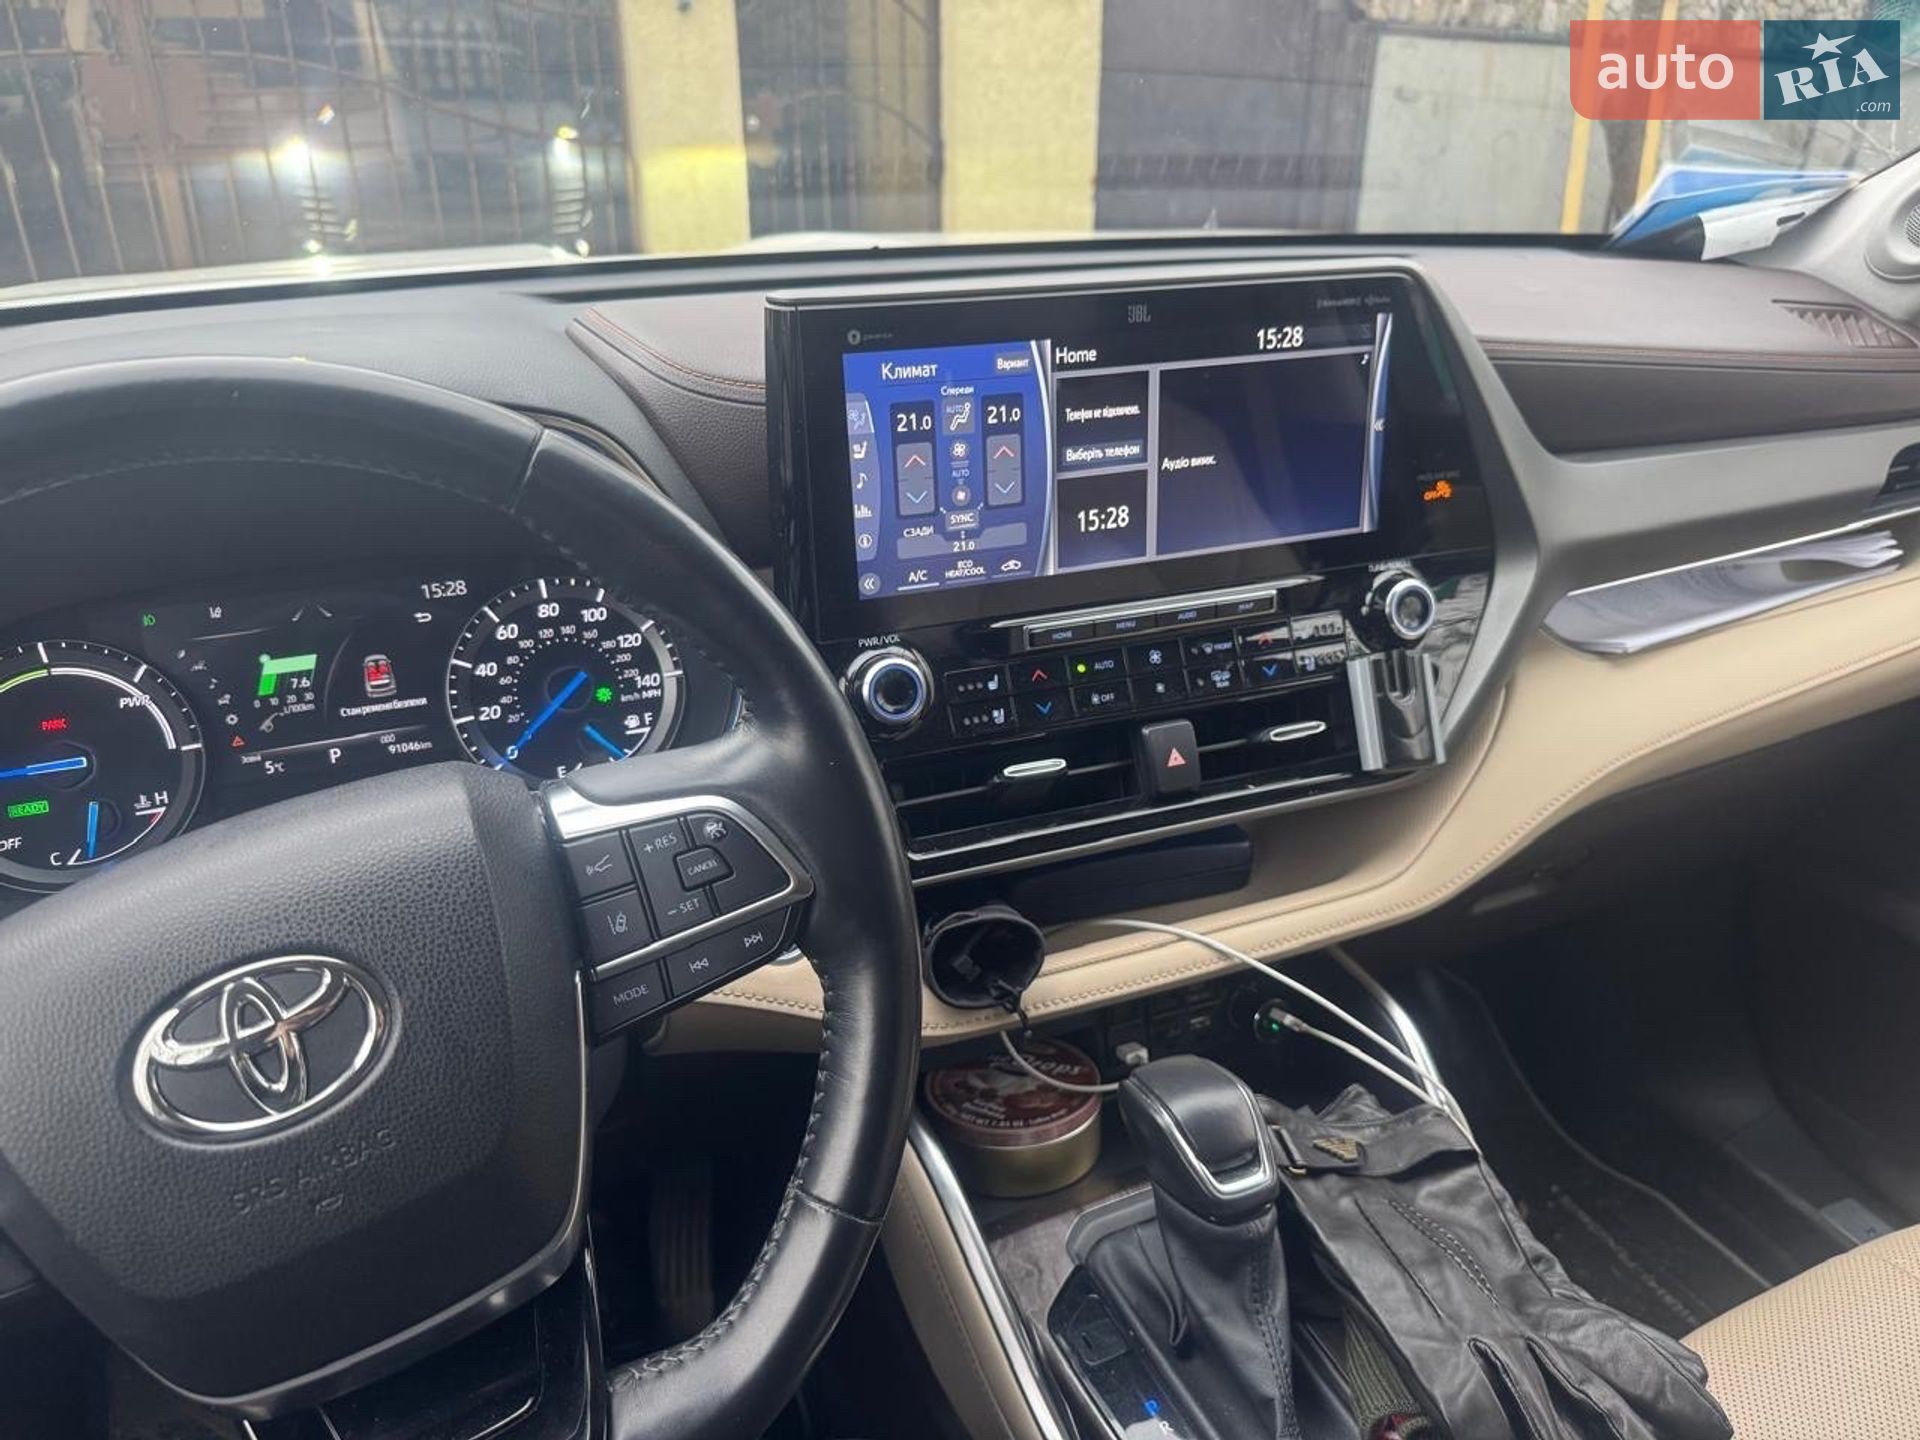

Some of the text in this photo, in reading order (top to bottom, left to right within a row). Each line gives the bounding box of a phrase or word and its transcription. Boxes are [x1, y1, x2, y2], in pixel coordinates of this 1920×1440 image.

[1127, 303, 1151, 323] JBL
[1256, 325, 1303, 350] 15:28
[1055, 347, 1097, 364] Home
[881, 362, 939, 380] Климат
[987, 405, 1021, 424] 21.0
[896, 412, 932, 432] 21.0
[1066, 442, 1140, 462] Виберіть телефон
[1161, 456, 1190, 472] Аудіо
[952, 469, 970, 477] AUTO
[950, 513, 976, 525] SYNC
[1077, 505, 1130, 533] 15:28
[903, 526, 935, 538] СЗАДИ
[952, 541, 976, 552] 21.0
[957, 560, 974, 569] ECO
[908, 570, 928, 583] A/C
[421, 580, 467, 599] 15:28
[537, 603, 560, 618] 80
[581, 607, 608, 623] 100
[496, 624, 519, 640] 60
[538, 629, 554, 638] 120
[560, 625, 576, 635] 140
[583, 629, 598, 639] 160
[518, 639, 535, 648] 100
[617, 633, 642, 648] 120
[506, 655, 520, 665] 80
[616, 653, 632, 662] 200
[1094, 659, 1115, 670] AUTO
[475, 662, 498, 678] 40
[290, 677, 311, 690] 7.6
[499, 676, 512, 685] 60
[635, 673, 661, 688] 140
[286, 694, 297, 704] 20
[304, 692, 315, 702] 30
[642, 689, 661, 700] MPH
[1100, 693, 1115, 702] OFF
[119, 695, 151, 709] PWR
[478, 705, 501, 721] 20
[644, 712, 653, 726] F
[329, 748, 342, 765] P
[557, 765, 567, 779] E
[154, 790, 169, 805] H
[10, 802, 48, 816] READY
[50, 852, 62, 866] C
[687, 860, 718, 877] CANCEL
[614, 984, 649, 1005] MODE
[1143, 1399, 1157, 1417] P
[1159, 1420, 1174, 1436] R
